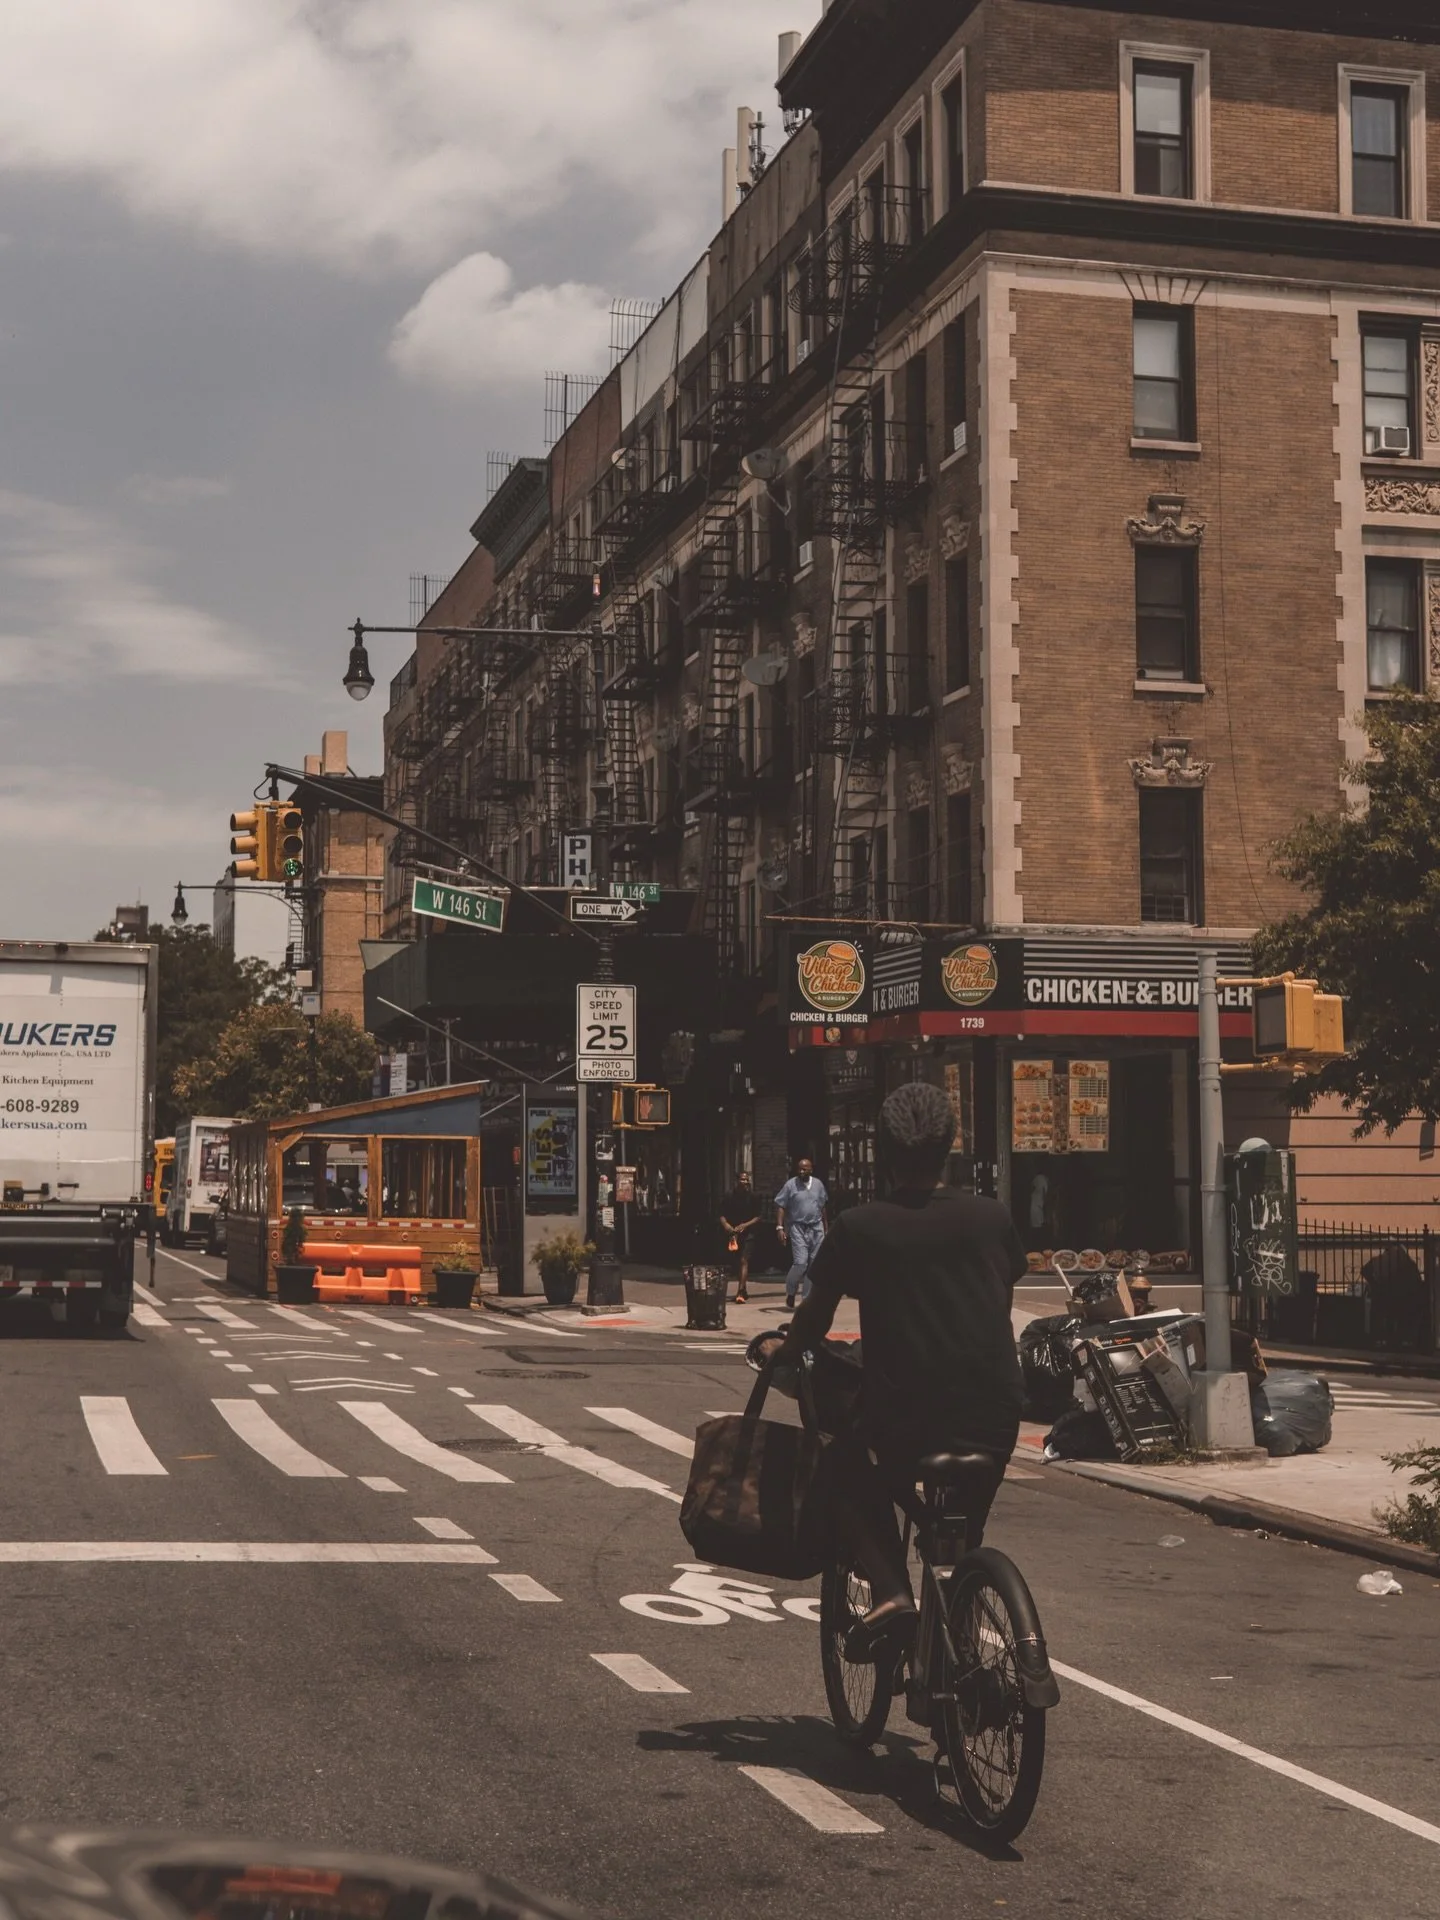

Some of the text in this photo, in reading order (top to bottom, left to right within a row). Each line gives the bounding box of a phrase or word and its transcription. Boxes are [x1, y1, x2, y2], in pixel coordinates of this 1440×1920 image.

[615, 885, 624, 898] W
[628, 885, 646, 899] 146
[433, 889, 487, 921] W 146 St
[581, 904, 631, 915] ONE WAY
[798, 955, 854, 981] Village
[941, 958, 989, 978] Village
[809, 974, 862, 994] Chicken
[951, 974, 997, 991] Chicken
[594, 990, 617, 998] CITY
[880, 988, 887, 1011] &
[888, 981, 919, 1010] BURGER
[1027, 978, 1128, 1005] CHICKEN
[1135, 979, 1154, 1005] &
[589, 1001, 622, 1010] SPEED
[593, 1012, 619, 1021] LIMIT
[790, 1012, 868, 1023] CHICKEN & BURGER
[960, 1017, 985, 1029] 1739
[0, 1023, 117, 1046] UKERS
[586, 1024, 628, 1051] 25
[21, 1050, 58, 1058] Appliance
[592, 1061, 622, 1069] PHOTO
[583, 1069, 630, 1077] ENFORCED
[2, 1075, 94, 1087] Kitchen Equipment
